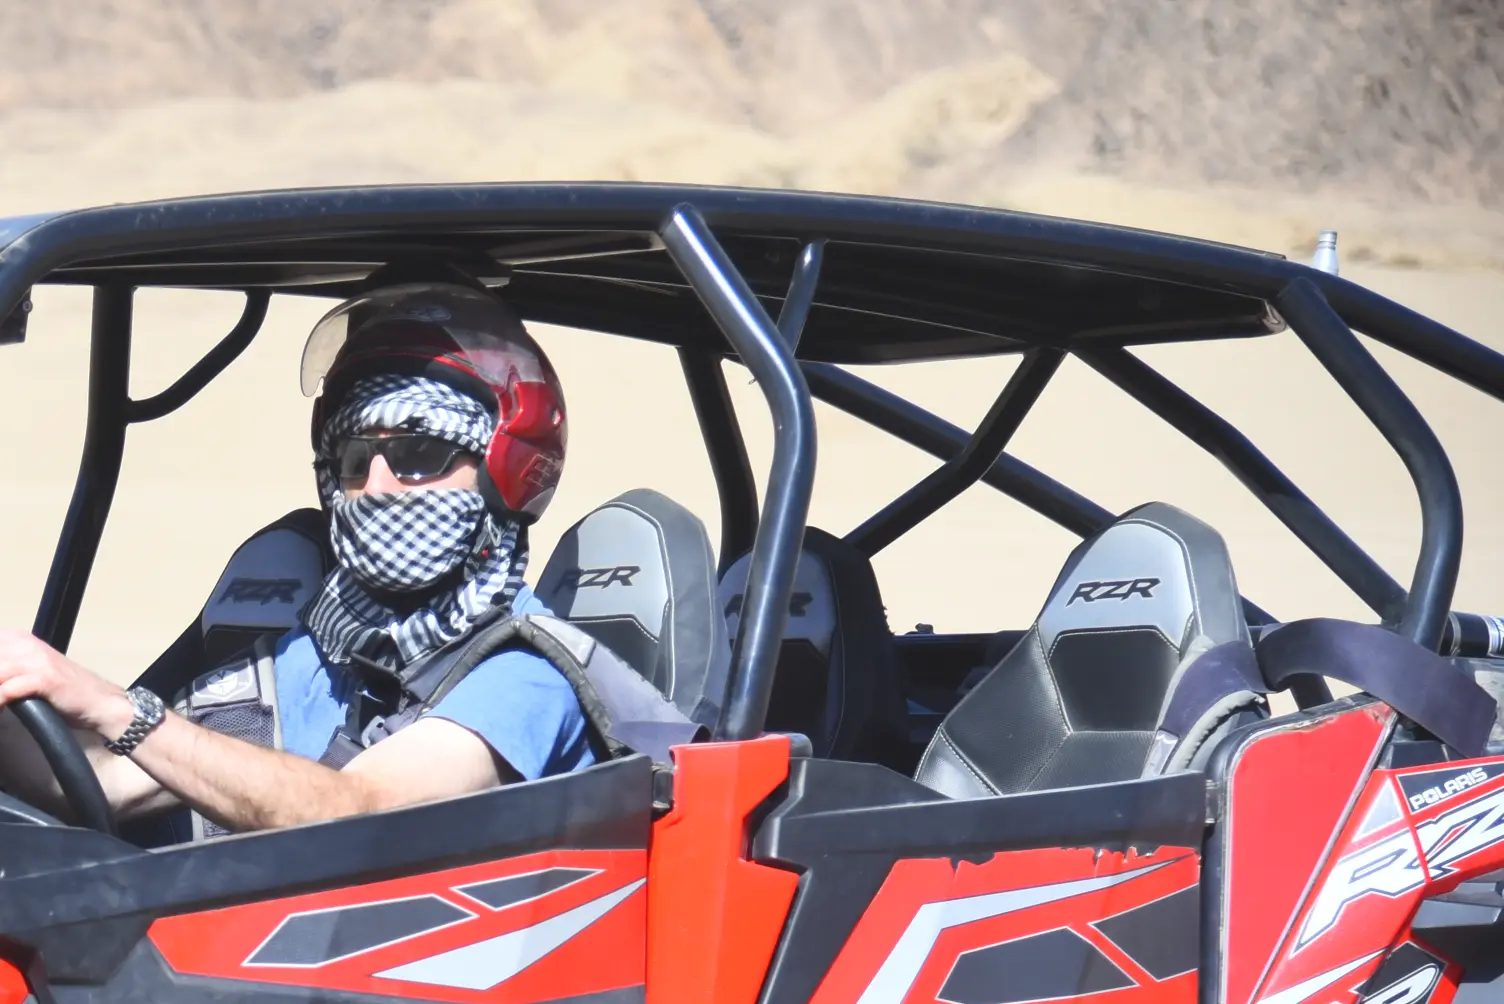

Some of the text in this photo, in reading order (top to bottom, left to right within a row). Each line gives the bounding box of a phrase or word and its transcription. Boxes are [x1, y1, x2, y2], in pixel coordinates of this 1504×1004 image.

[551, 565, 642, 599] RZR
[1064, 577, 1161, 607] RZR
[1409, 767, 1489, 811] POLARIS
